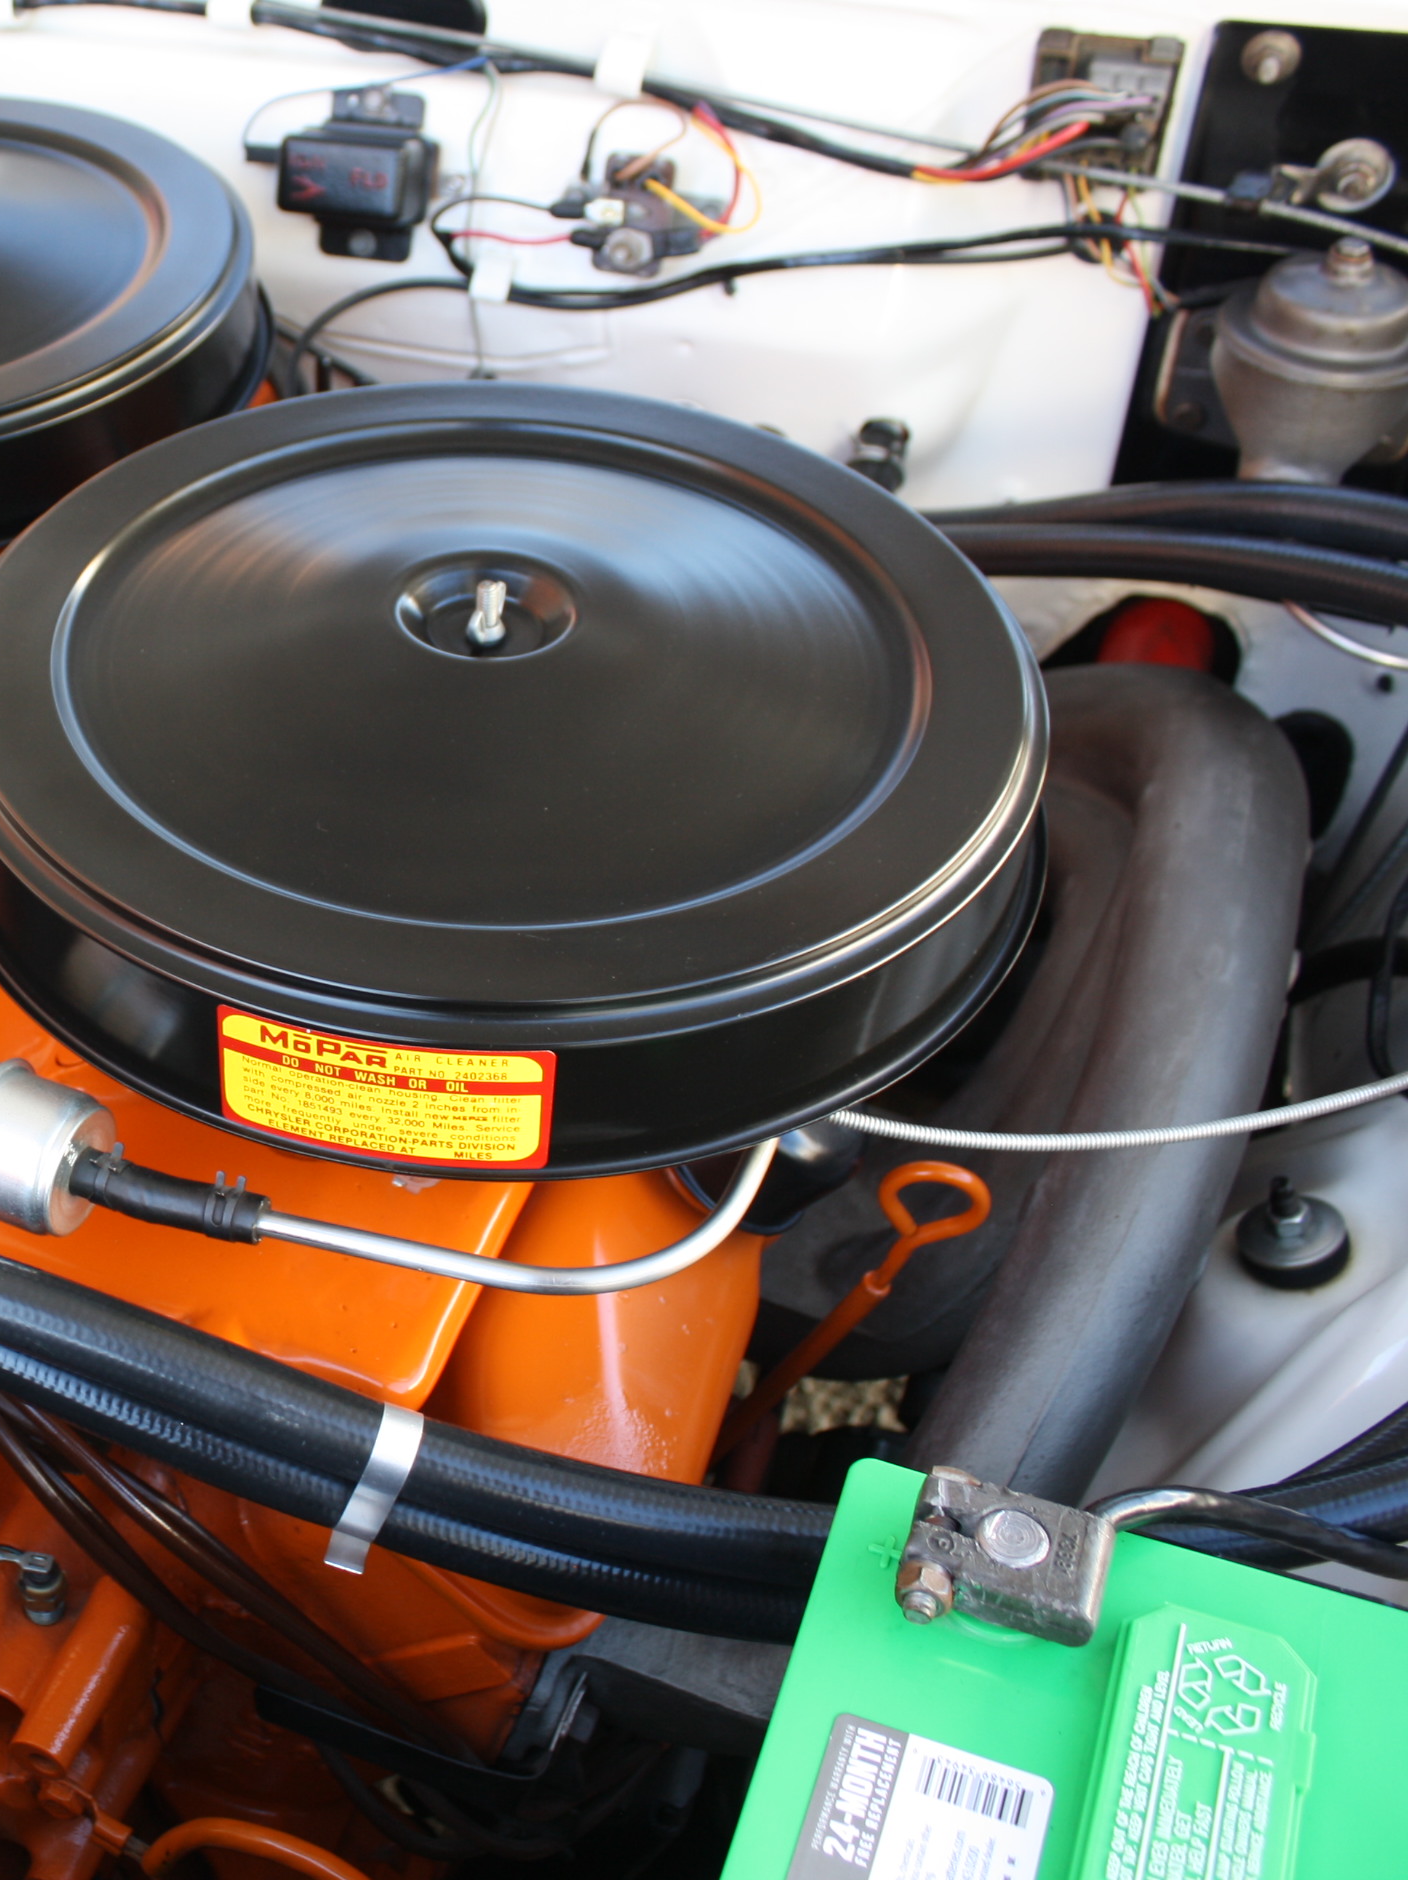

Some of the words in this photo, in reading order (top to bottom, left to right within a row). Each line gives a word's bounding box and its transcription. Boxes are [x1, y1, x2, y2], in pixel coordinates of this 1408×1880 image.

[242, 1056, 282, 1073] Normal
[289, 1070, 381, 1094] operation-clean
[449, 1095, 485, 1103] Clean
[282, 1055, 300, 1067] DO
[315, 1063, 341, 1076] NOT
[354, 1071, 396, 1086] WASH
[408, 1079, 427, 1090] OR
[445, 1082, 469, 1092] OIL
[394, 1066, 423, 1076] PART
[429, 1071, 445, 1079] NO
[455, 1072, 508, 1081] 2402368
[395, 1053, 421, 1062] AIR
[436, 1057, 509, 1067] CLEANER
[243, 1067, 265, 1078] with
[271, 1075, 341, 1097] compressed
[347, 1092, 362, 1100] air
[369, 1097, 406, 1107] nozzle
[412, 1100, 419, 1108] 2
[425, 1103, 466, 1113] inches
[243, 1076, 265, 1087] side
[271, 1084, 300, 1098] every
[381, 1107, 418, 1118] Install
[425, 1113, 448, 1121] new
[243, 1085, 265, 1096] part
[298, 1099, 343, 1116] 1851493
[349, 1112, 381, 1124] every
[244, 1095, 272, 1107] more
[283, 1105, 341, 1126] frequently
[353, 1122, 386, 1132] under
[399, 1129, 438, 1138] severe
[450, 1134, 516, 1142] conditions
[247, 1104, 310, 1127] CHRYSLER
[458, 1143, 516, 1151] DIVISION
[268, 1119, 325, 1138] ELEMENT
[329, 1134, 396, 1151] REPLACED
[400, 1146, 416, 1154] AT
[454, 1151, 493, 1160] MILES
[1186, 1637, 1233, 1654] RETURN
[1270, 1680, 1289, 1733] RECYCLE
[822, 1727, 887, 1863] 24-MONTH
[854, 1831, 875, 1868] FREE
[865, 1737, 901, 1830] REPLACEMENT
[811, 1790, 836, 1851] PERFORMANCE
[1174, 1810, 1192, 1840] GET
[1193, 1800, 1212, 1838] FAST
